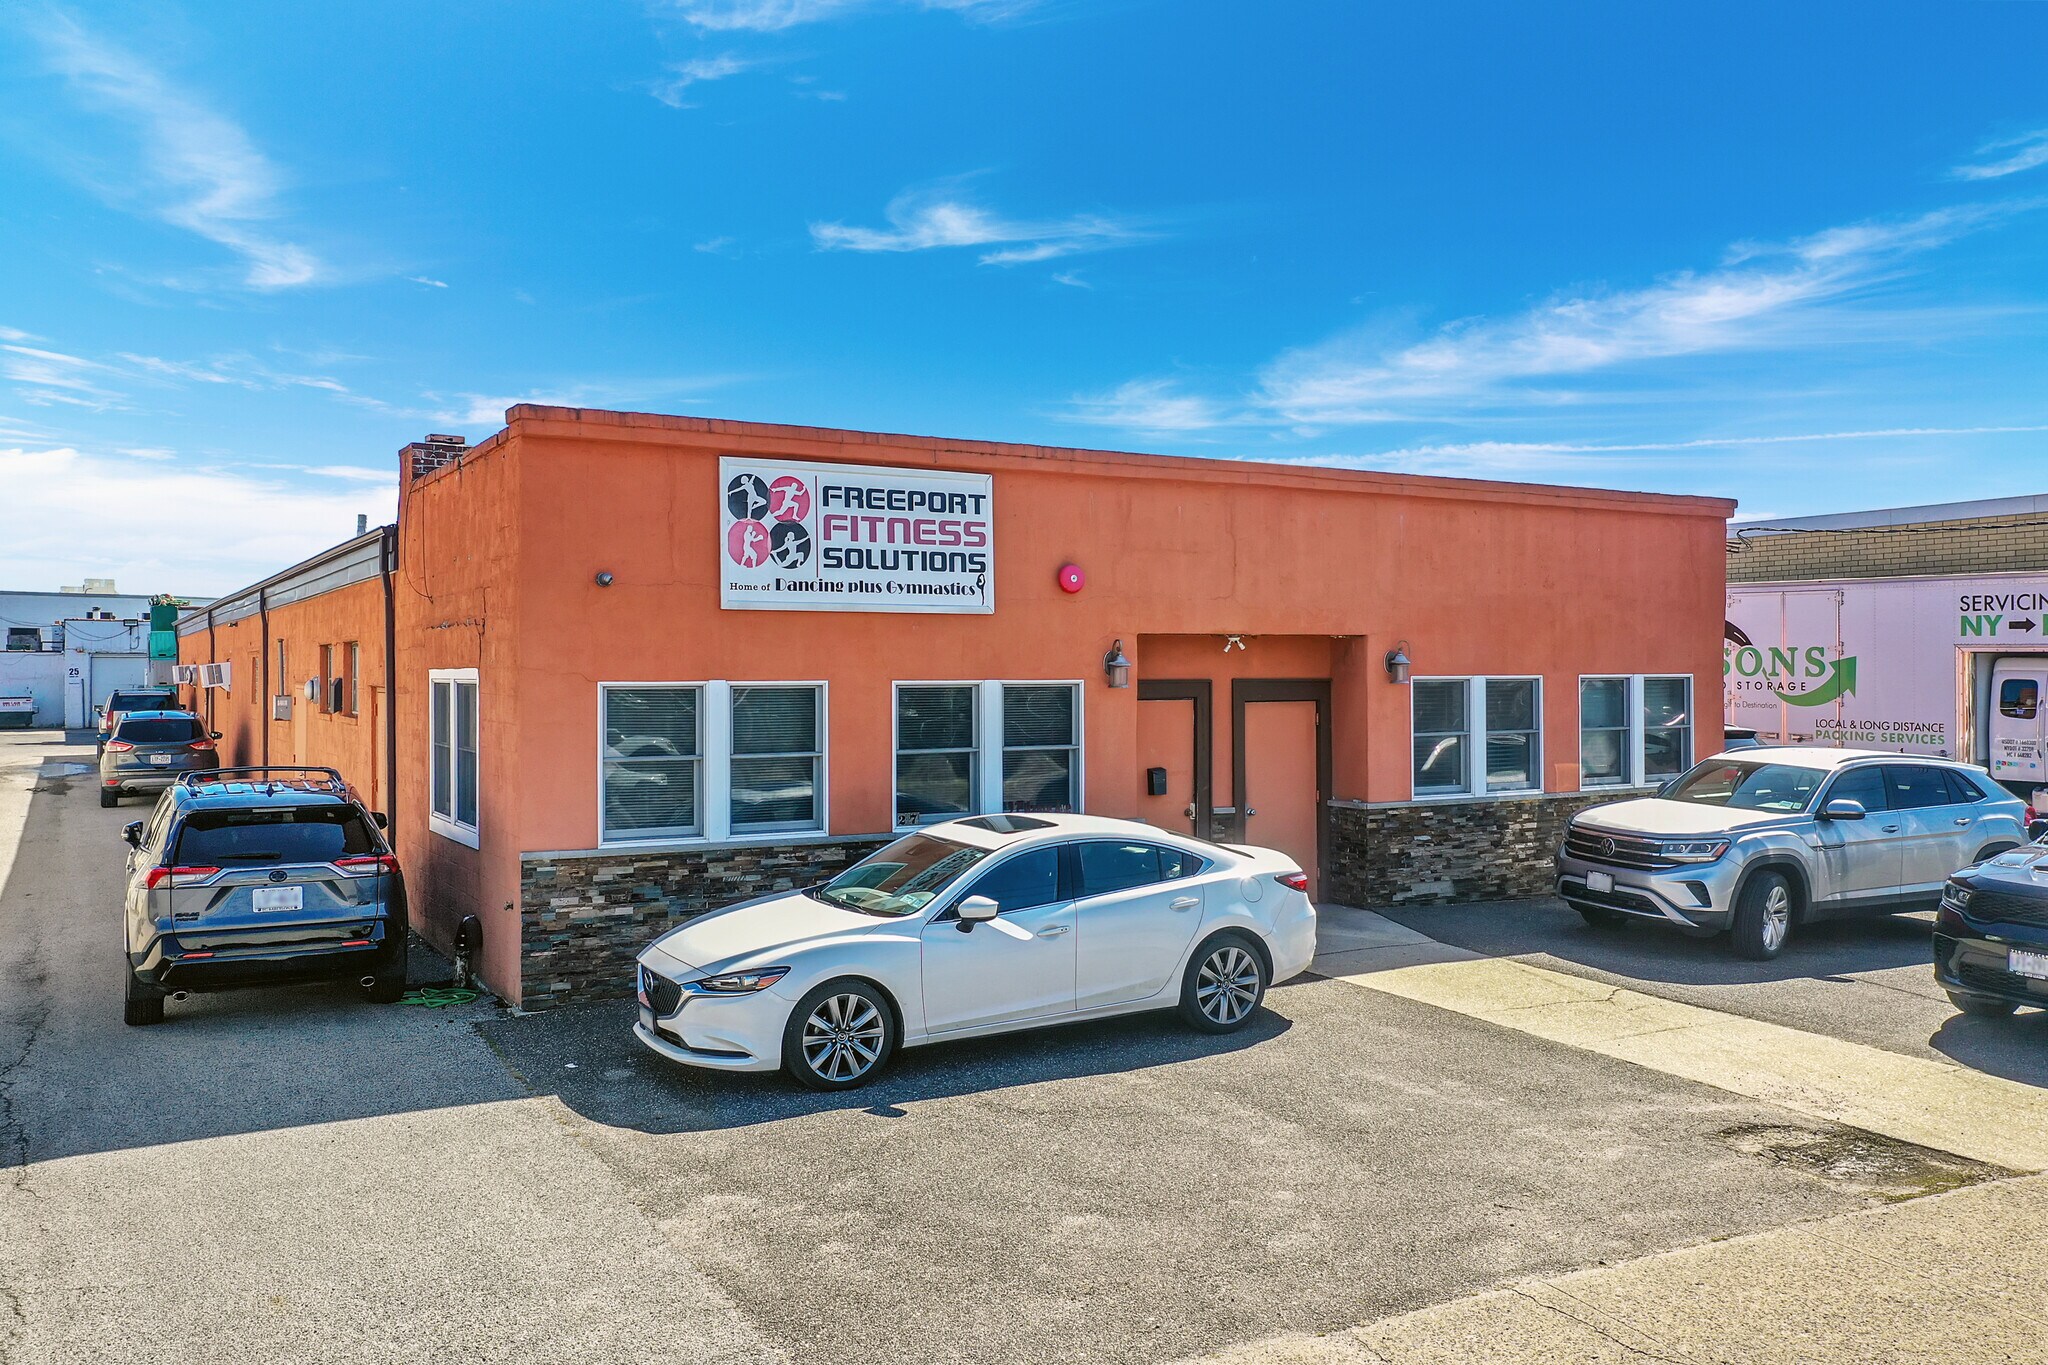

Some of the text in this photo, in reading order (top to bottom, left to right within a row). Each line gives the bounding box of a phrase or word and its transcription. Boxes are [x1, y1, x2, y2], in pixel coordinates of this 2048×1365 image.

[822, 485, 987, 515] FREEPORT
[823, 514, 987, 547] FITNESS
[823, 547, 987, 573] SOLUTIONS
[729, 577, 976, 596] Home of Dancing plus Gymnastics
[1960, 614, 2004, 637] NY
[68, 667, 80, 676] 25
[1736, 681, 1806, 691] STORAGE
[1742, 700, 1778, 709] Destination
[1815, 718, 1945, 733] LOCAL & LONG DISTANCE
[1815, 729, 1945, 745] PACKING SERVICES
[898, 813, 918, 826] 27
